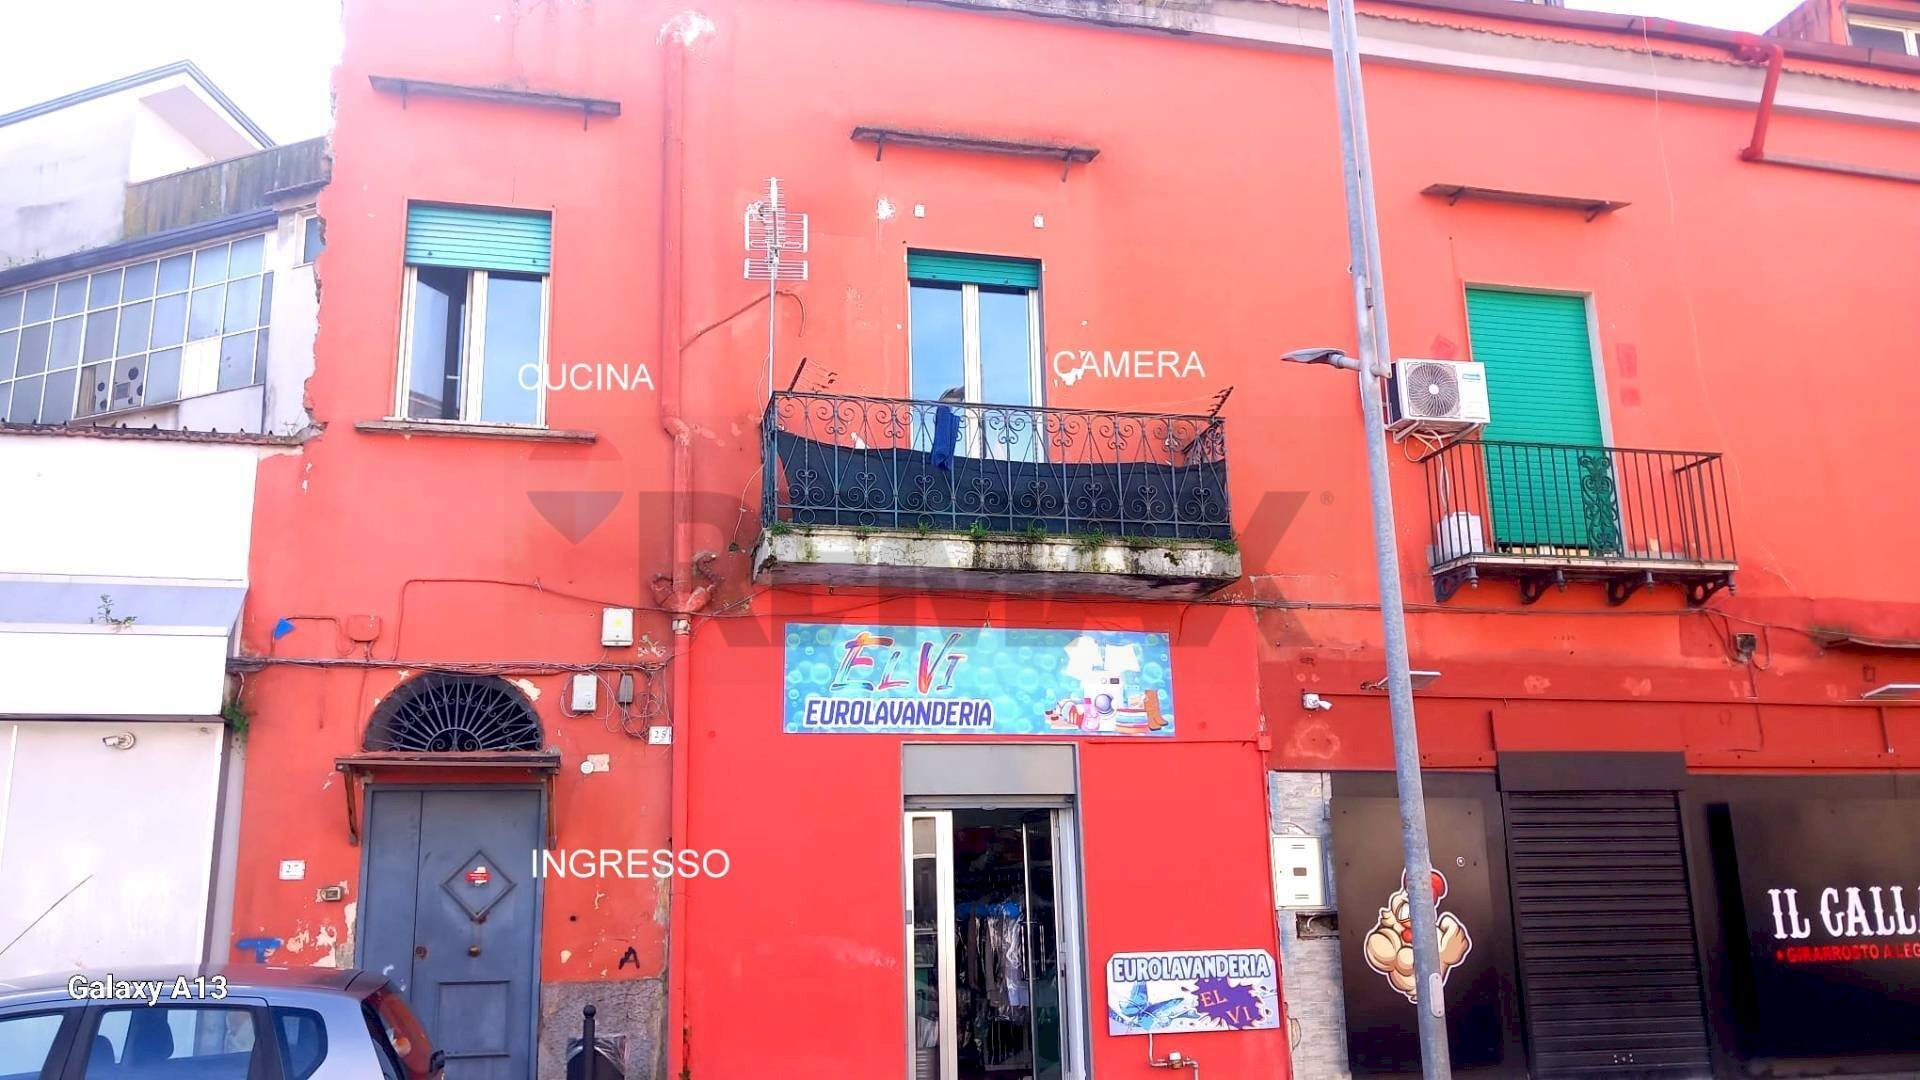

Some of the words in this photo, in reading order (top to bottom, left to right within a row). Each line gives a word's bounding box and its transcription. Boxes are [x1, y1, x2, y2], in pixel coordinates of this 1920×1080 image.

[805, 699, 992, 727] EUROLAVANDERIA
[1767, 888, 1811, 940] IL
[1820, 886, 1920, 938] GALL
[1785, 943, 1880, 963] GIRARROSTO
[1112, 953, 1271, 982] EUROLAVANDERIA
[1200, 988, 1227, 1009] EL
[1226, 1004, 1250, 1025] VI
